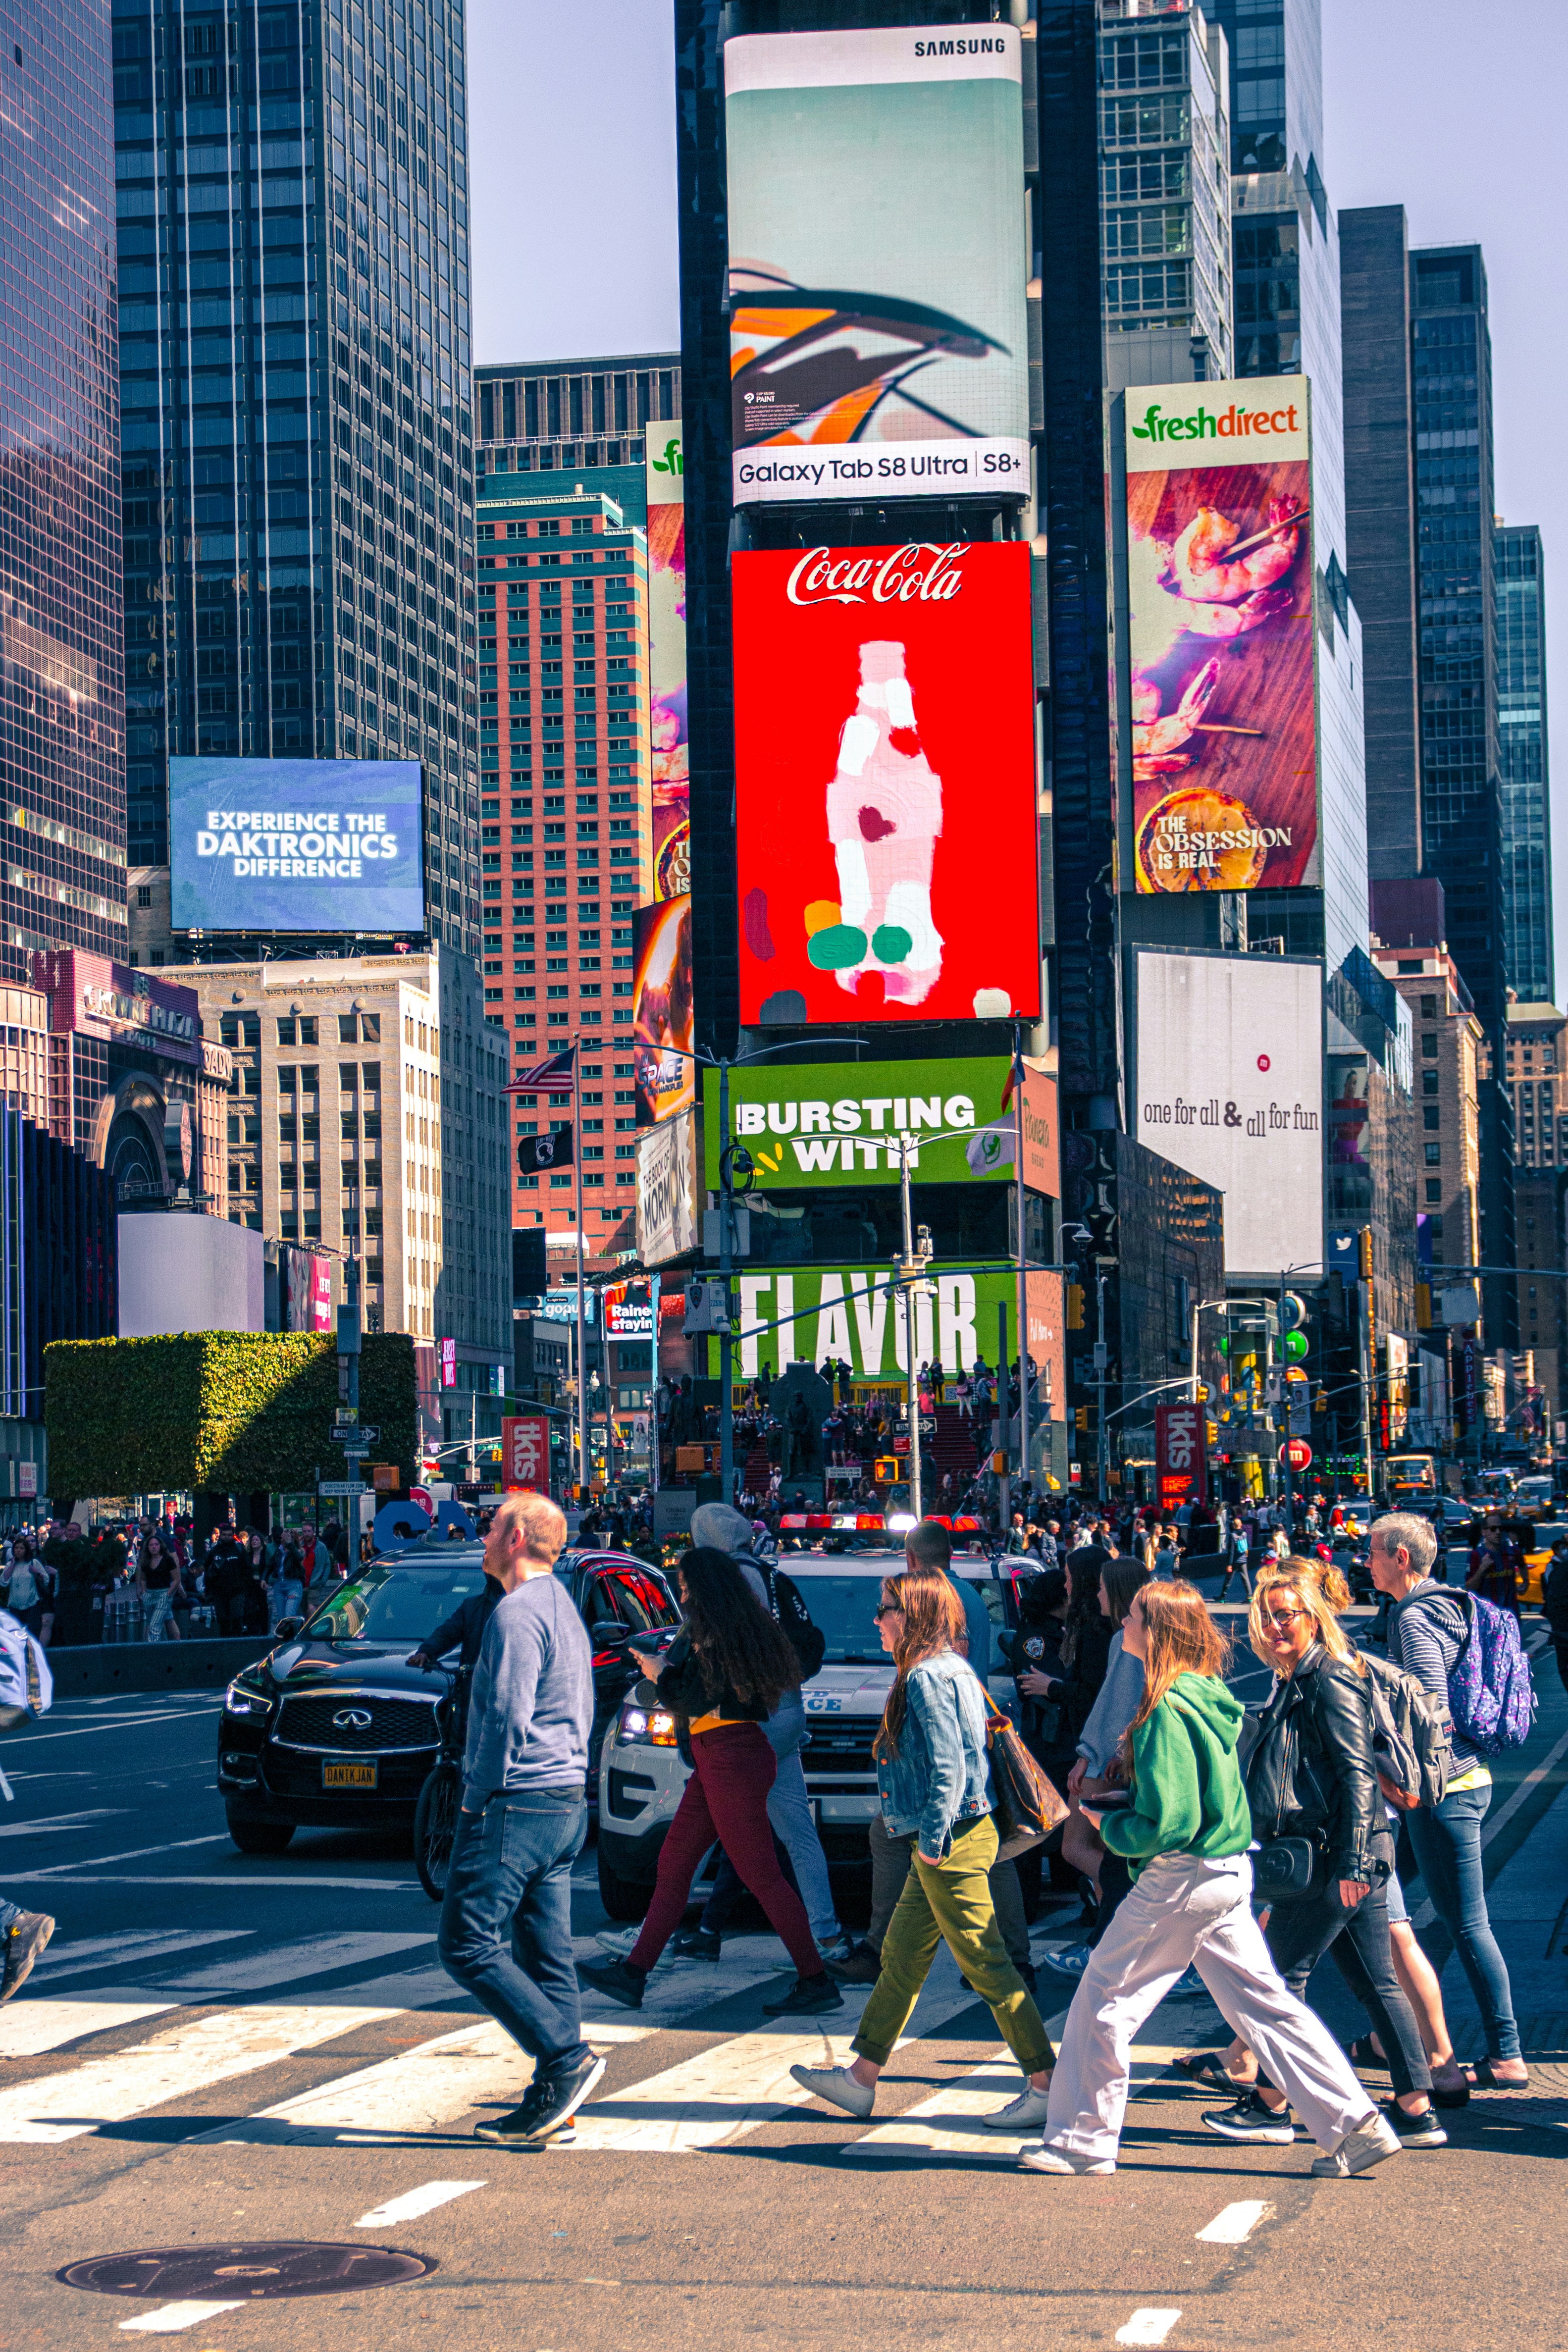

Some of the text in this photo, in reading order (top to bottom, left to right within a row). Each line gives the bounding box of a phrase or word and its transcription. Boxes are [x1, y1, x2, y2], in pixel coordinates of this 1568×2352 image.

[915, 38, 1005, 57] SAMSUNG
[1144, 405, 1299, 442] freshdirect
[739, 453, 1021, 485] Galaxy Tab S8 Ultra S8+
[787, 543, 972, 606] Coca-Cola
[208, 811, 386, 833] EXPERIENCE THE
[1157, 816, 1187, 833] THE
[198, 832, 398, 858] DAKTRONICS
[1156, 828, 1292, 853] OBSESSION
[234, 858, 362, 878] DIFFERENCE
[1158, 851, 1221, 870] IS REAL.
[638, 1057, 683, 1091] SPACE
[736, 1095, 975, 1135] BURSTING
[1144, 1098, 1319, 1137] one for all & all for fun
[792, 1137, 919, 1172] WITH
[651, 1156, 665, 1183] BOOK
[545, 1300, 591, 1317] gopuf
[514, 1422, 541, 1480] tkts
[1167, 1411, 1197, 1469] tkts
